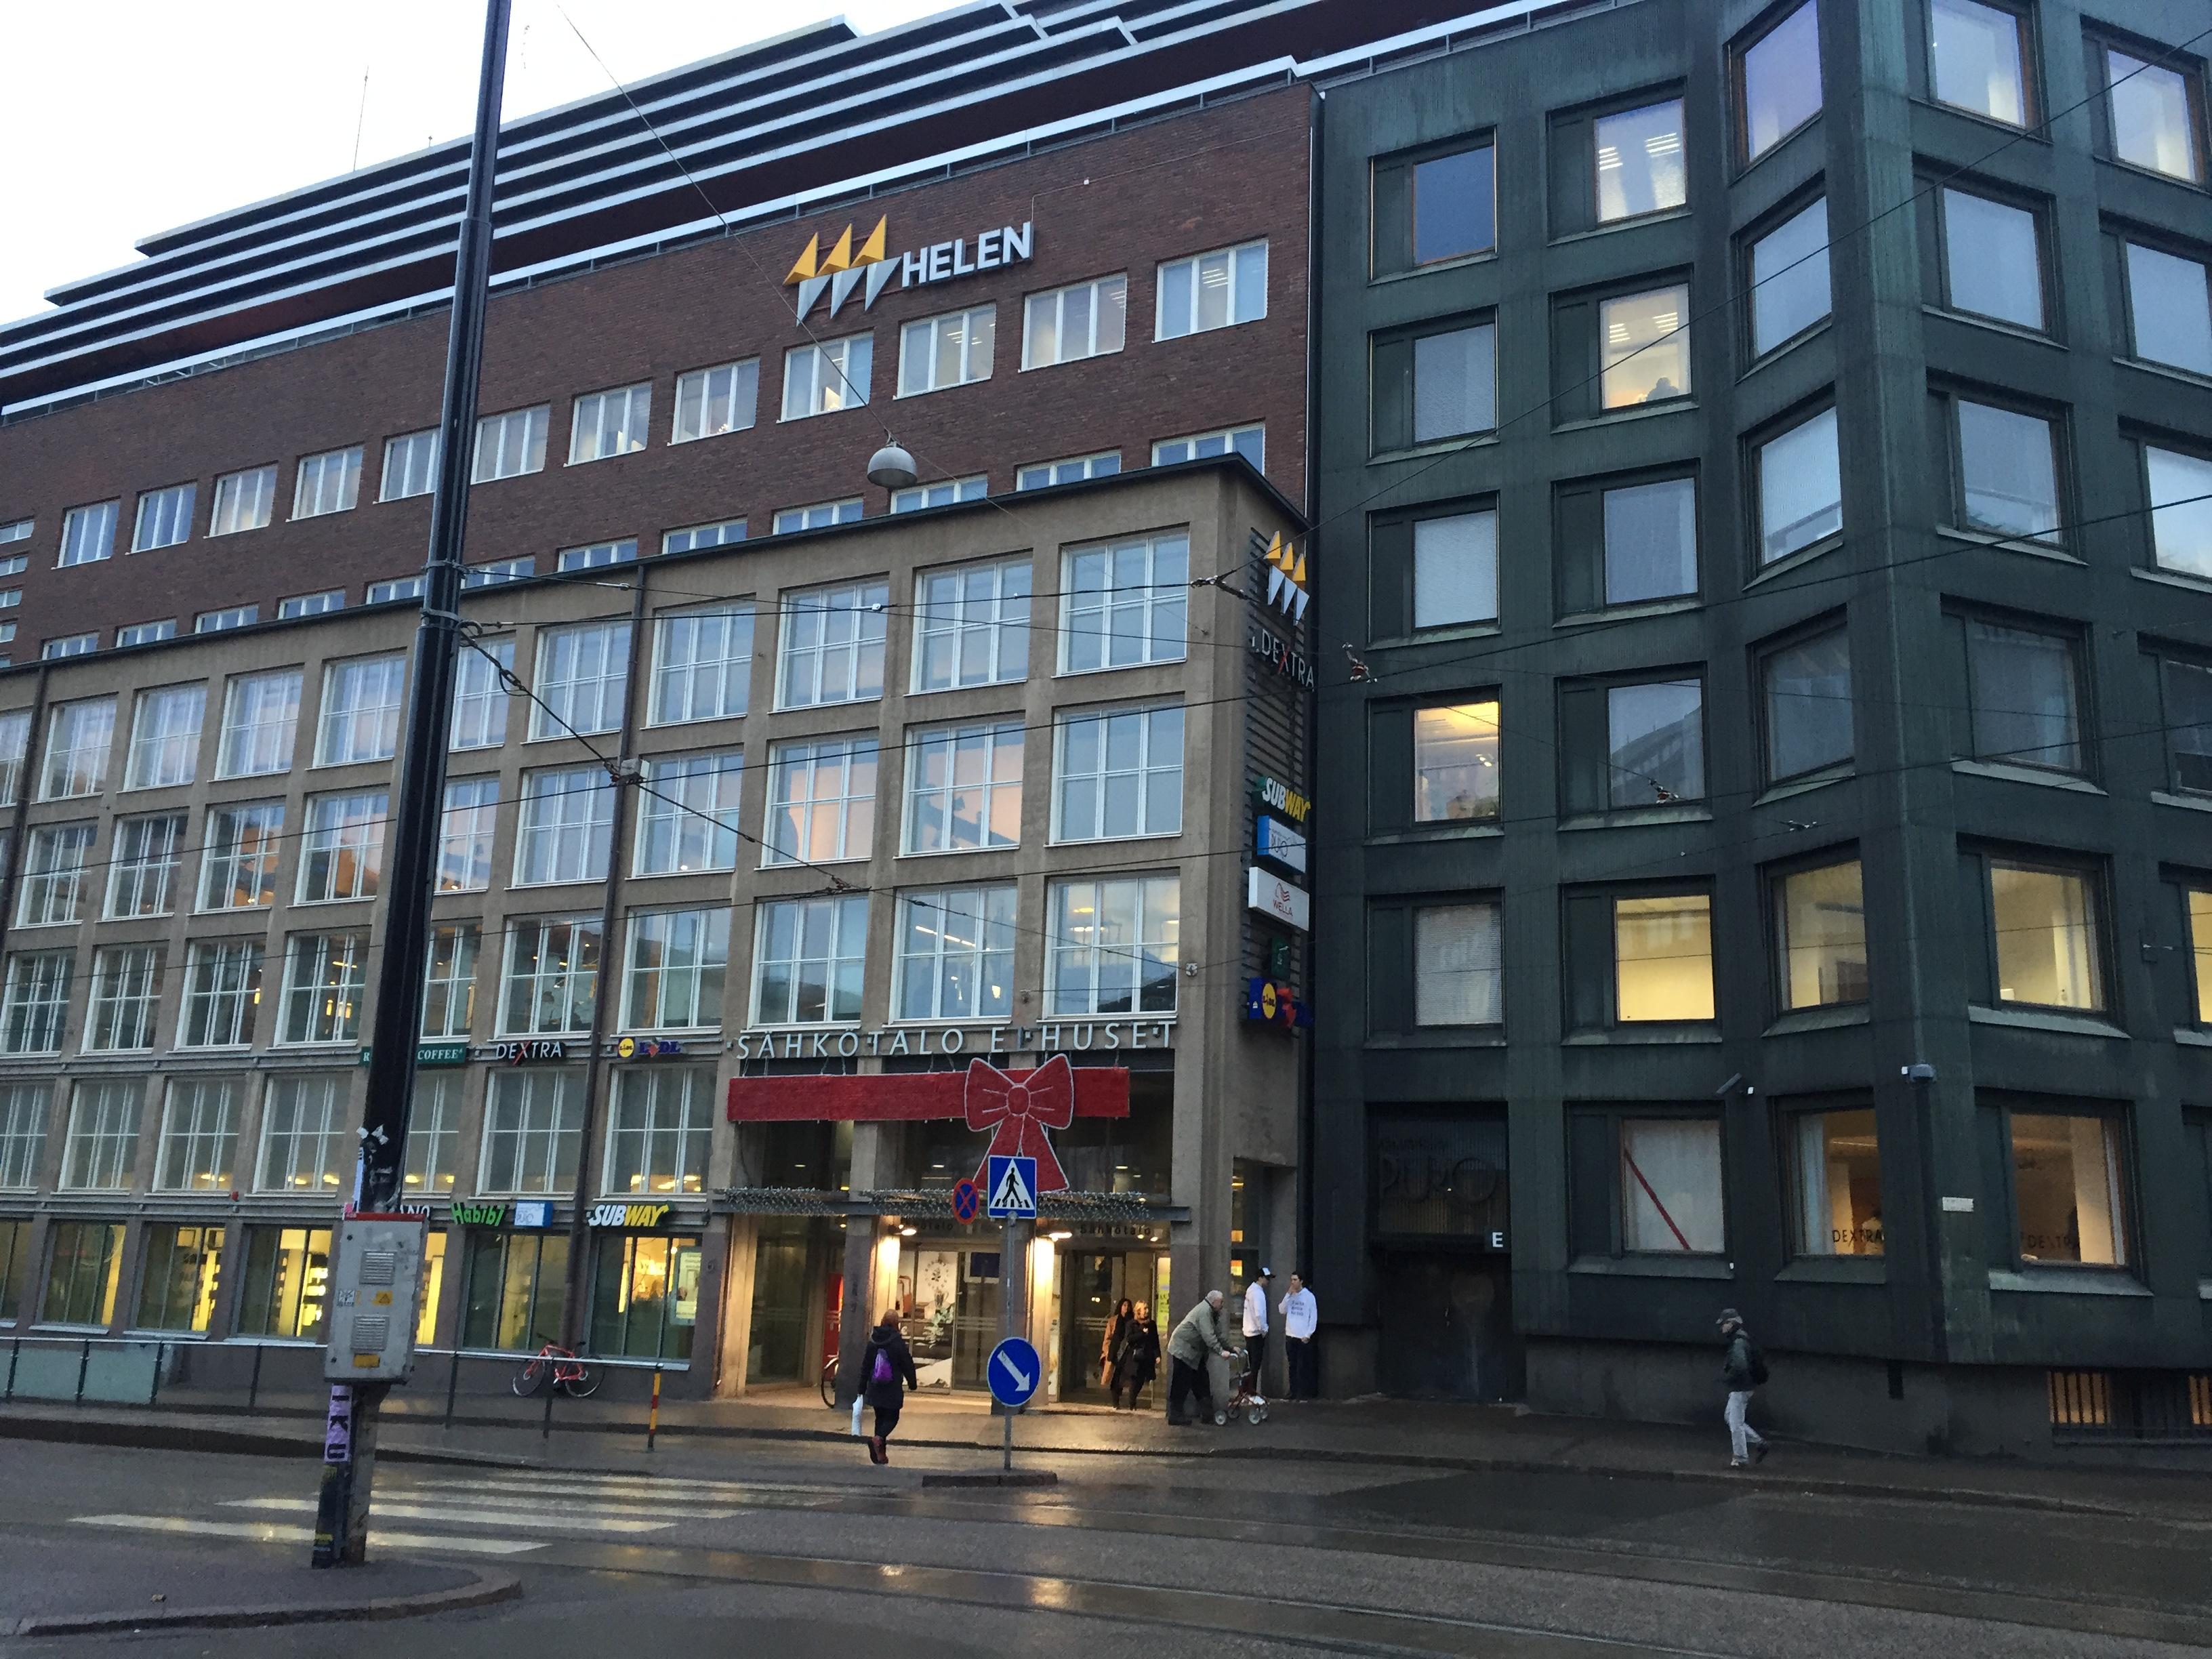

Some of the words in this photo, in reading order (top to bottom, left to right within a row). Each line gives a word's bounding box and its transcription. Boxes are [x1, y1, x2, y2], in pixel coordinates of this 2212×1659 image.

[901, 221, 1031, 287] HELEN
[1261, 628, 1314, 689] DEXTRA
[1261, 777, 1311, 823] SUBWAY
[495, 1040, 562, 1065] DEXTRA
[736, 1028, 964, 1060] SÄHKÖTALO
[451, 1202, 505, 1227] Habibi
[588, 1204, 670, 1227] SUBWAY
[1492, 1231, 1504, 1248] E
